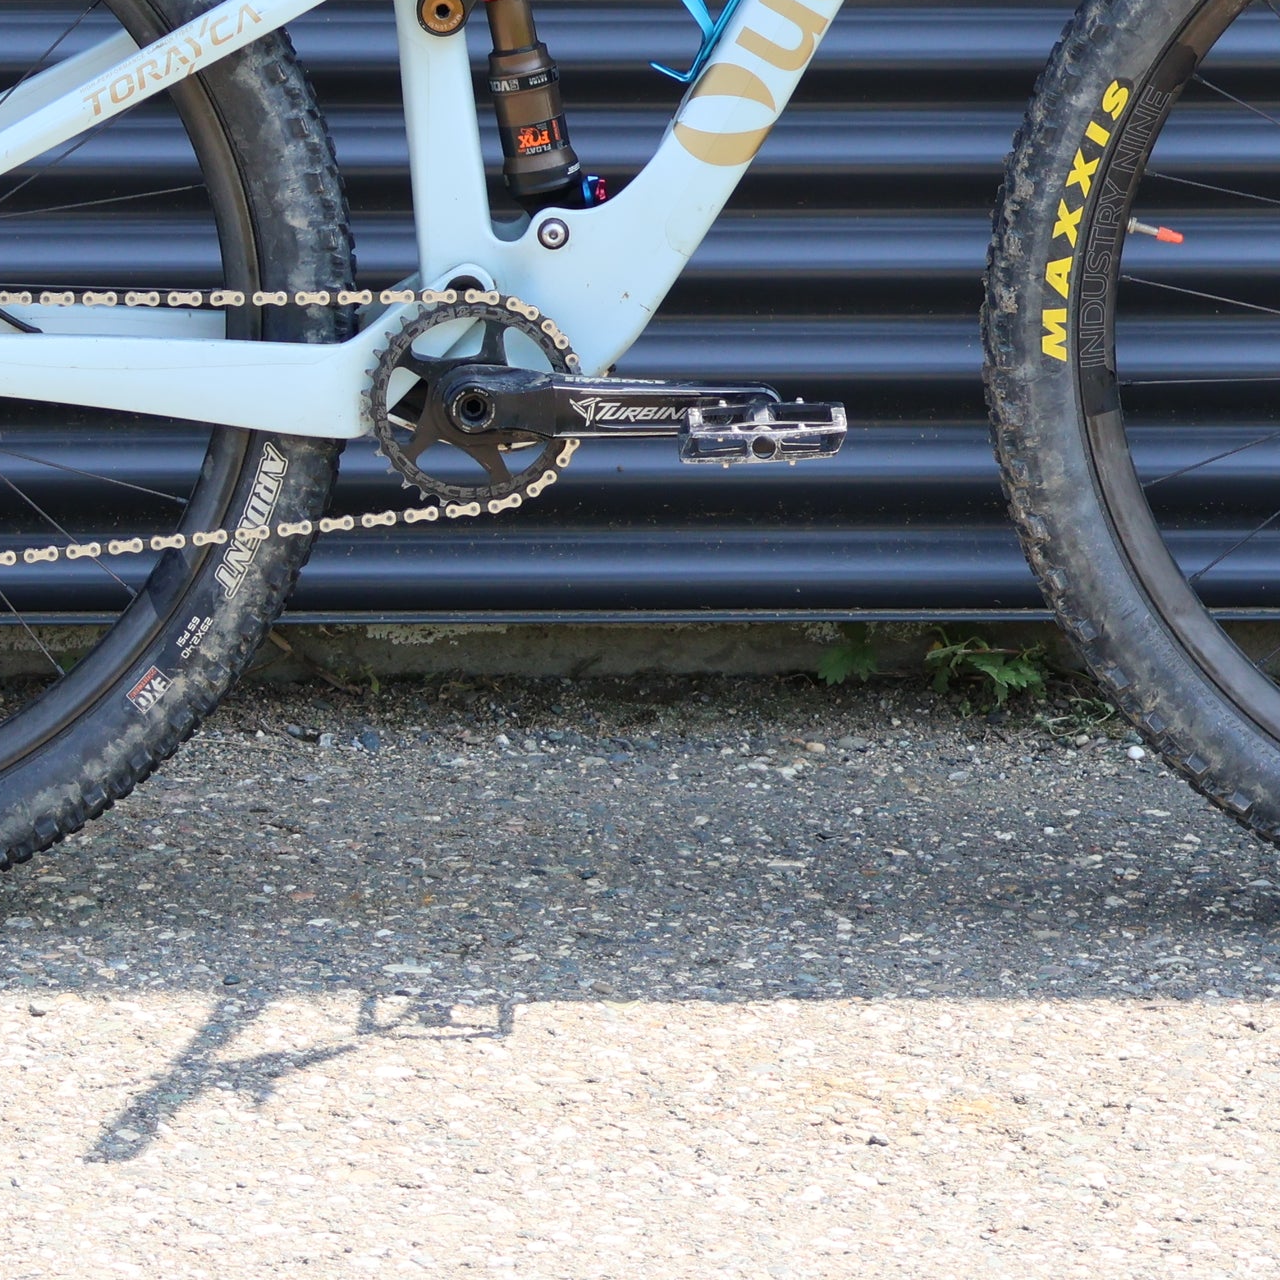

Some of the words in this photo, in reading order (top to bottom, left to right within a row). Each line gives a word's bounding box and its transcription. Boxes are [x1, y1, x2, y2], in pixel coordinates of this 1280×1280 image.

[82, 3, 263, 117] TORAYCA
[518, 128, 552, 148] FOX
[525, 143, 552, 156] FLOAT
[1041, 79, 1130, 363] MAXXIS
[1079, 178, 1128, 369] INDUSTRY
[1119, 84, 1171, 175] NINE
[593, 402, 688, 422] TURBIN
[180, 616, 214, 659] 29X2.40
[187, 616, 201, 632] 65
[175, 630, 191, 648] PSI
[134, 673, 171, 711] EXO
